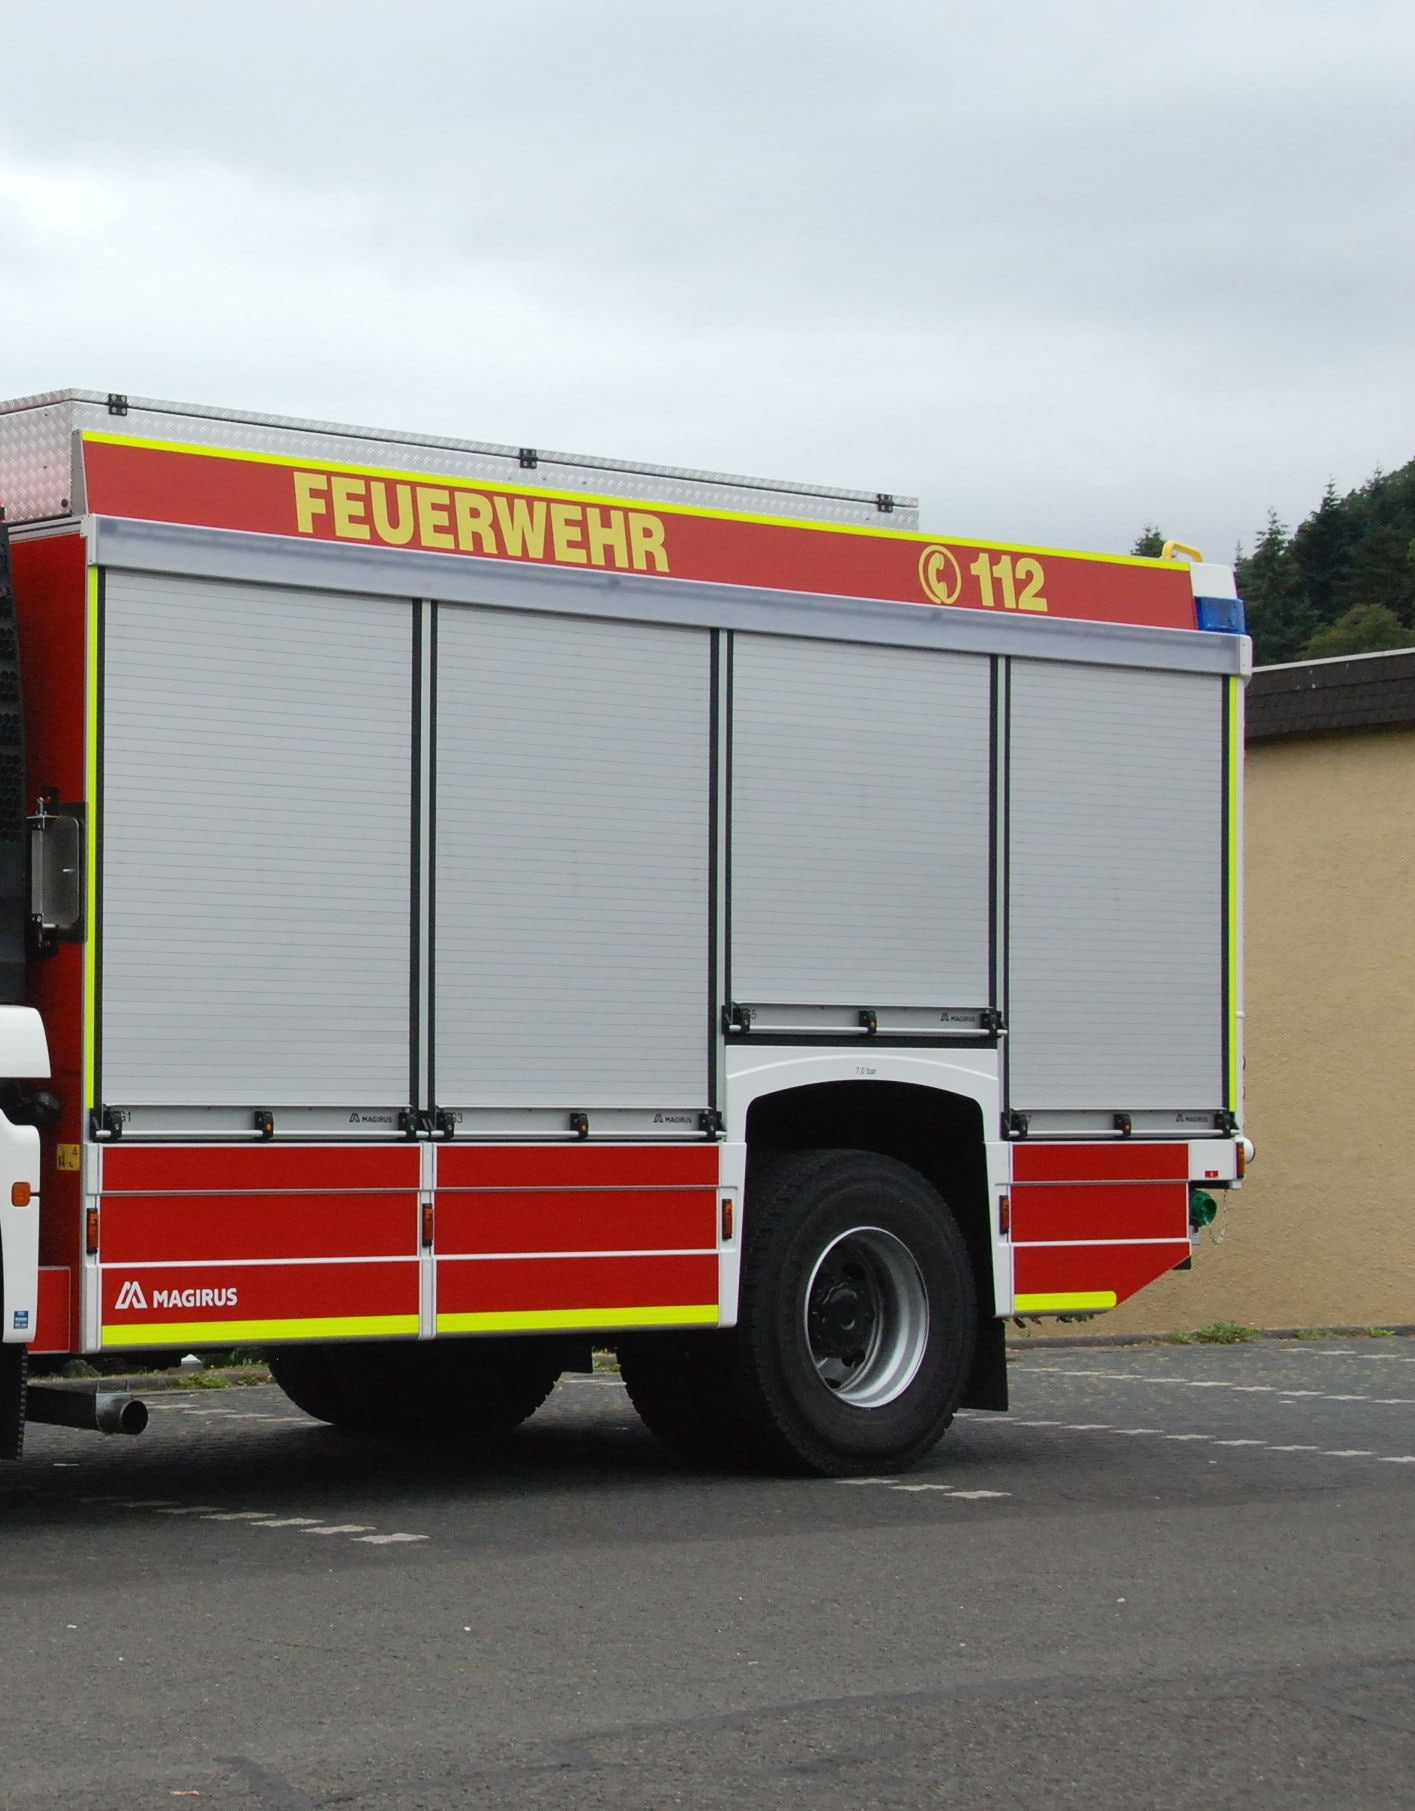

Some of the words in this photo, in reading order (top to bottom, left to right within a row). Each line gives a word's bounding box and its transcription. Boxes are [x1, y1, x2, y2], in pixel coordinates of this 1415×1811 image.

[293, 471, 670, 573] FEUERWEHR
[970, 552, 1048, 612] 112
[361, 1115, 392, 1124] MAGIRUS
[664, 1115, 692, 1124] MAGIRUS
[152, 1287, 238, 1309] MAGIRUS
